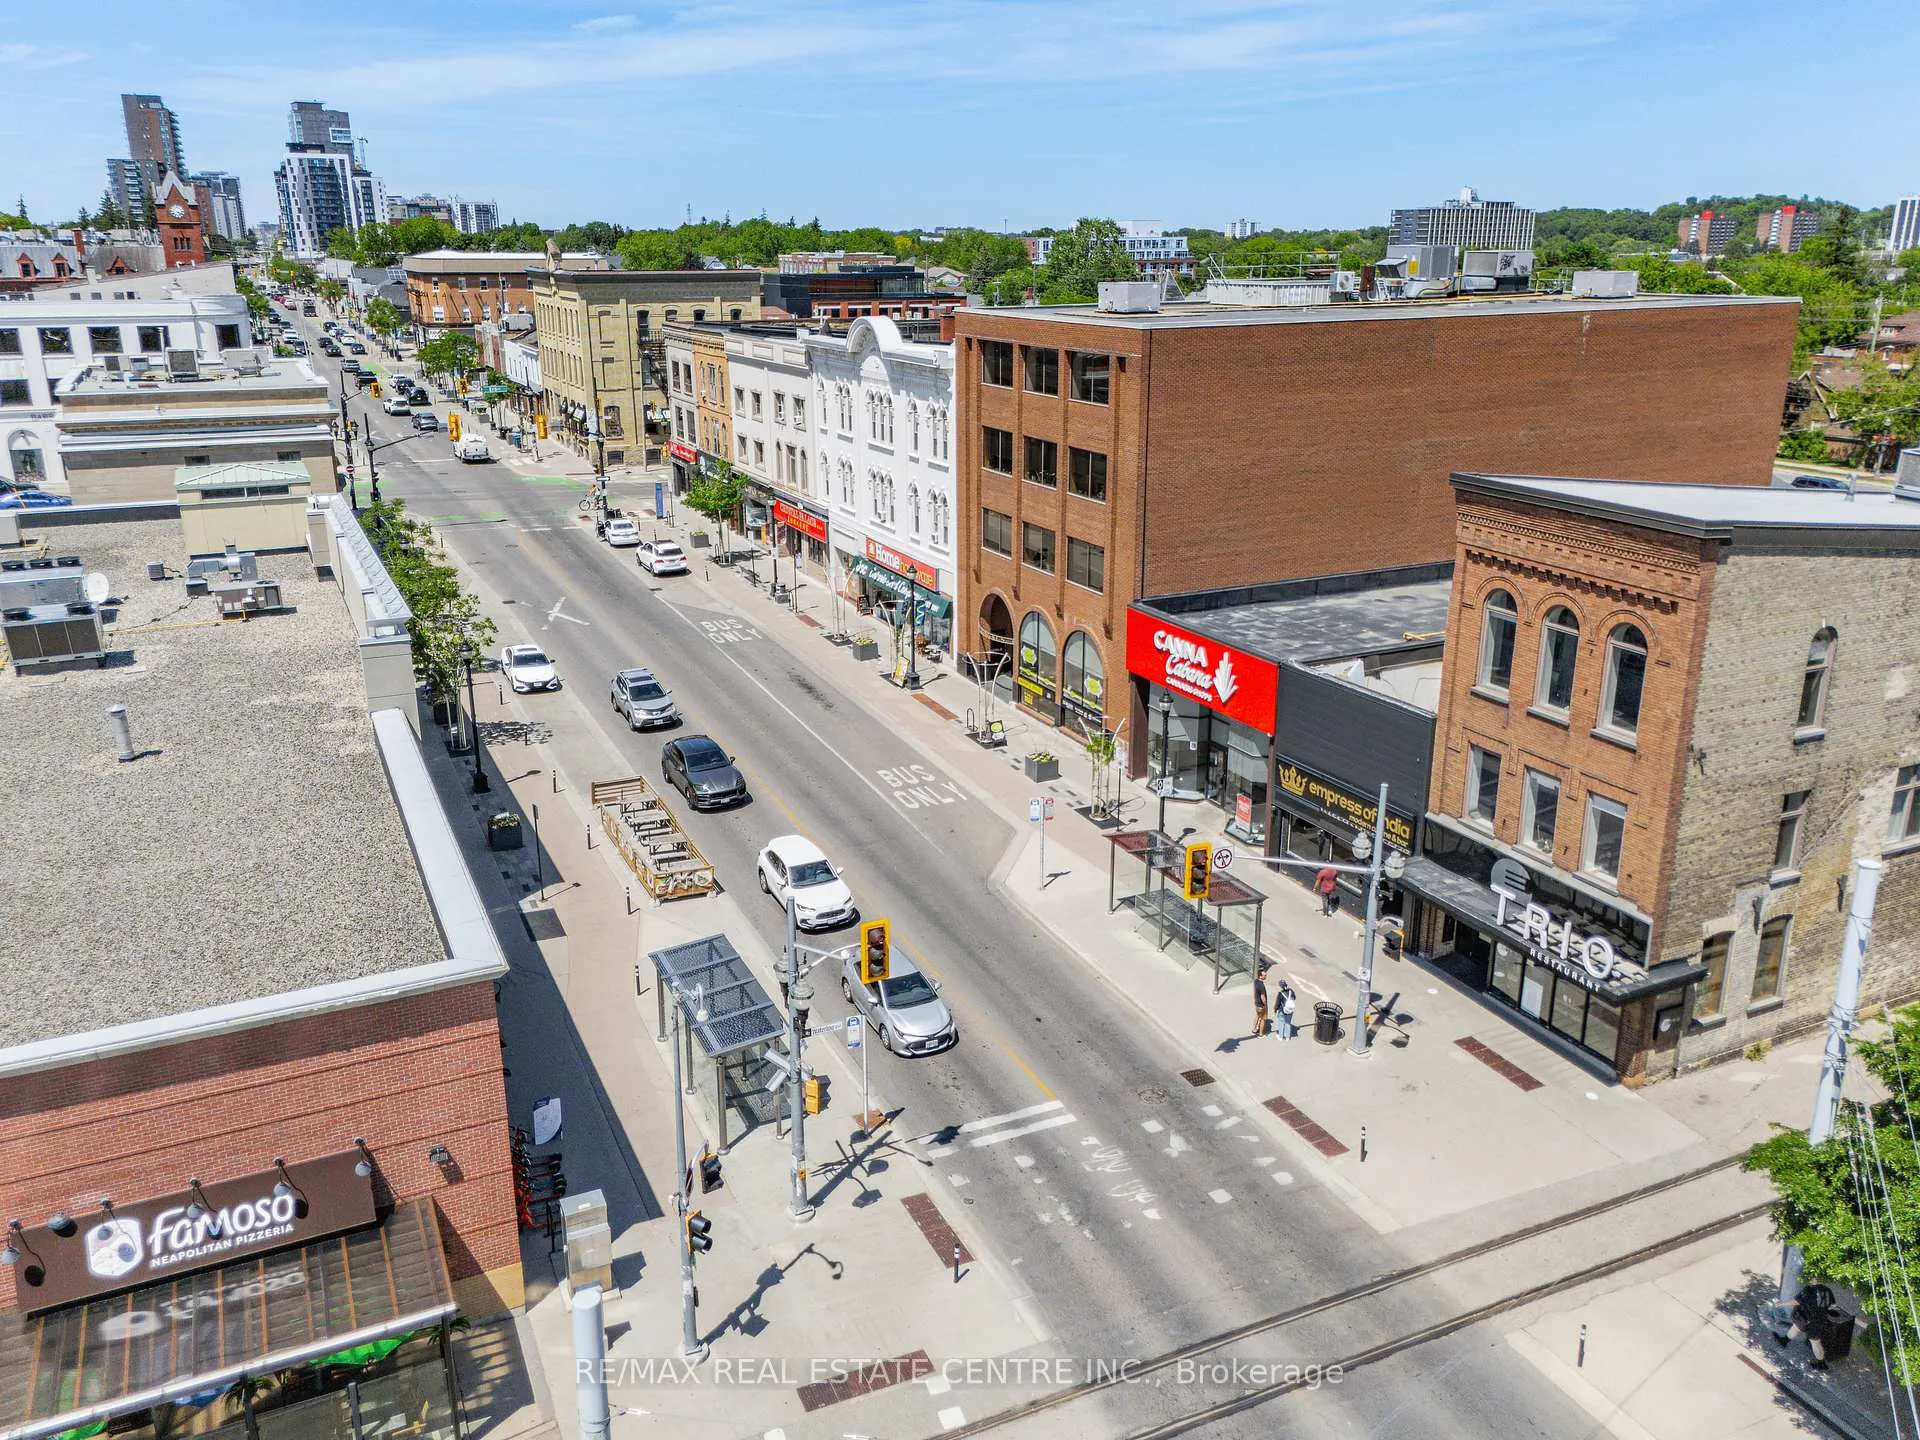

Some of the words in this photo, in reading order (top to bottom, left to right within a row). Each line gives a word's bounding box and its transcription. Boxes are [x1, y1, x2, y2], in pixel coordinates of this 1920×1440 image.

[700, 619, 743, 632] BUS
[707, 627, 763, 643] ONLY
[1154, 630, 1208, 668] CANNA
[876, 764, 936, 787] BUS
[893, 781, 968, 808] ONLY
[1309, 781, 1362, 817] empress
[1363, 806, 1378, 823] of
[1383, 817, 1411, 840] ndia
[1490, 883, 1614, 980] TRIO
[1529, 948, 1601, 993] RESTAURANT
[151, 1238, 233, 1268] NEAPOLITAN
[236, 1223, 295, 1247] PIZZERIA
